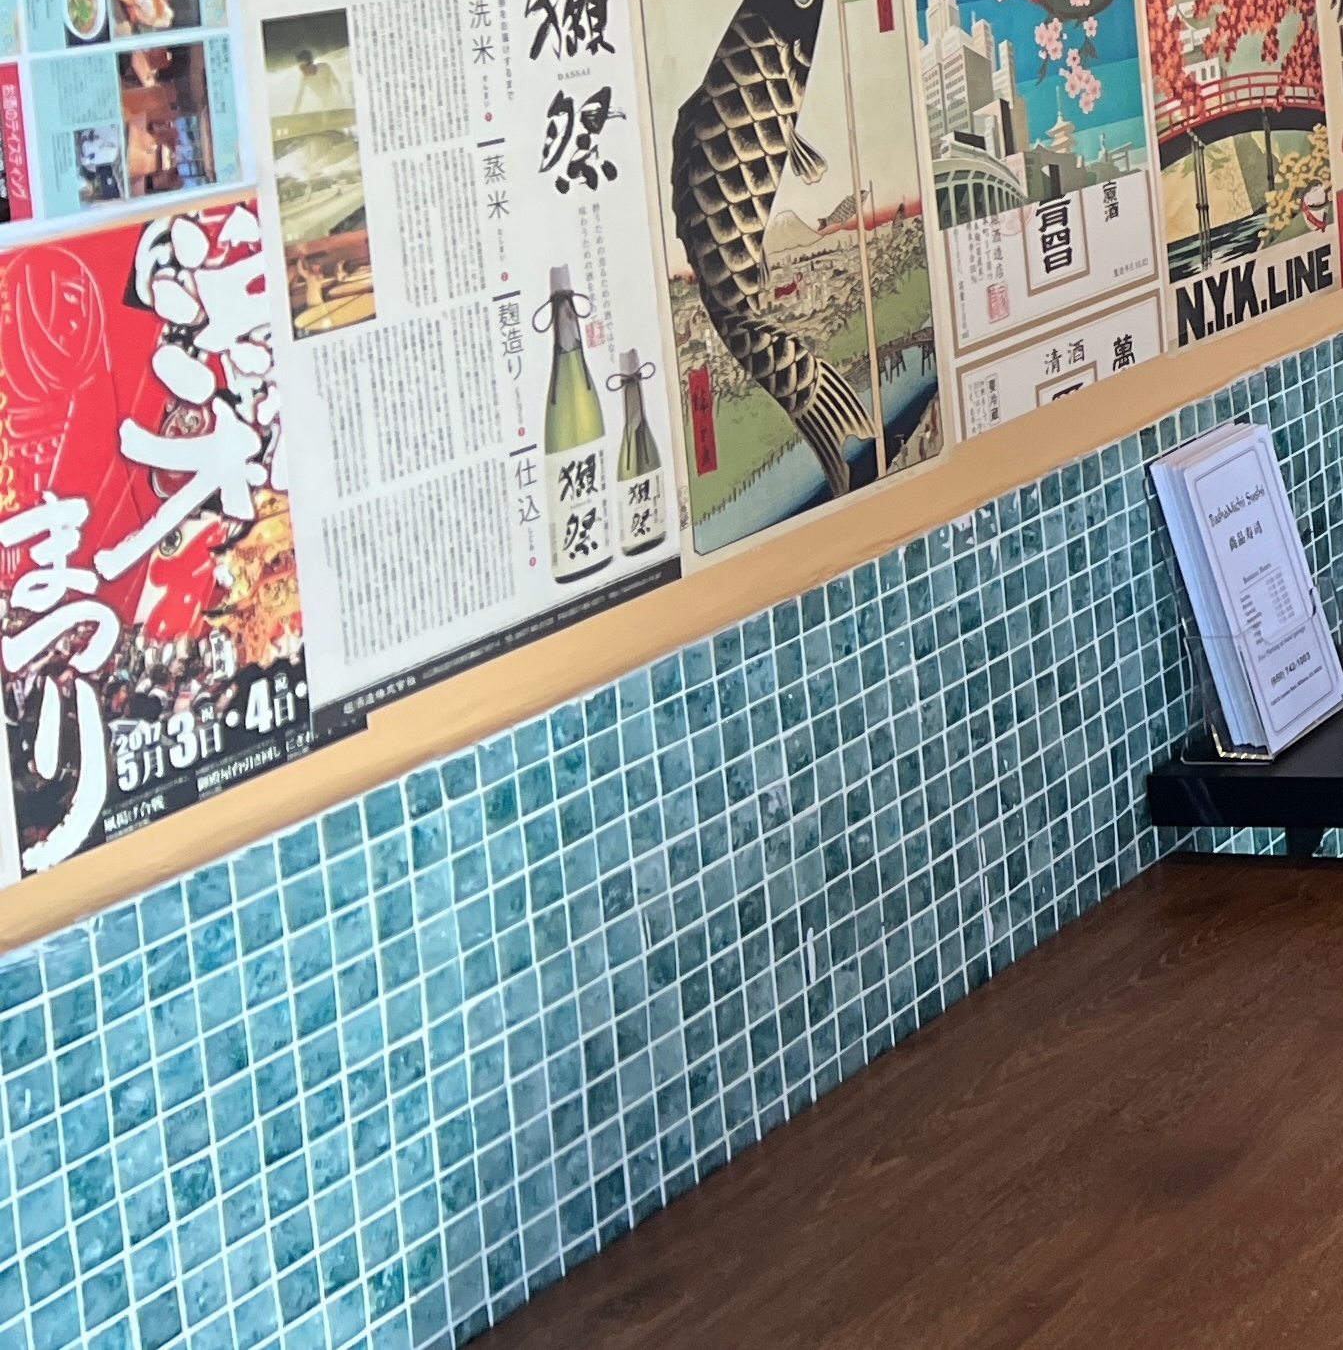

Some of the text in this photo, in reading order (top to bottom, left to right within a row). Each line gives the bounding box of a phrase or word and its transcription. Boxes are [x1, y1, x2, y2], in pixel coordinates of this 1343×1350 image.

[556, 67, 592, 81] DASSAI
[482, 153, 512, 221] 蒸米
[1268, 242, 1334, 308] LINE
[498, 301, 526, 382] 麹造り
[513, 457, 542, 527] 仕込
[557, 451, 605, 560] 獺祭
[116, 720, 162, 755] 2017
